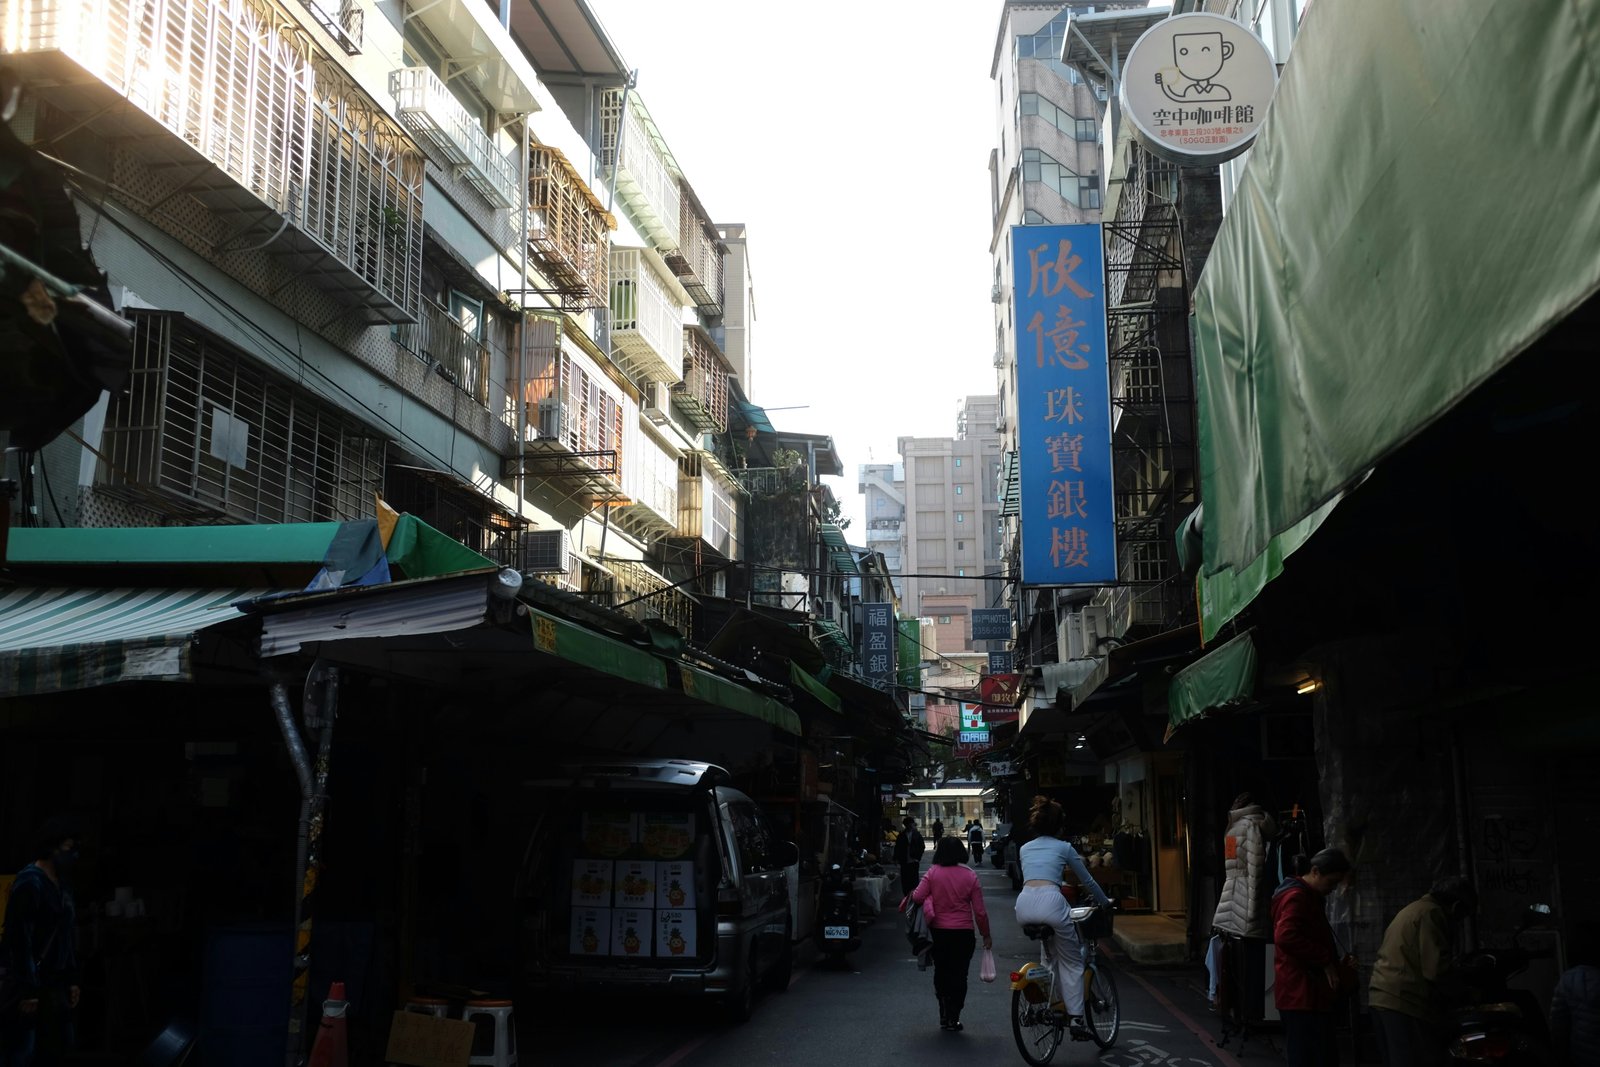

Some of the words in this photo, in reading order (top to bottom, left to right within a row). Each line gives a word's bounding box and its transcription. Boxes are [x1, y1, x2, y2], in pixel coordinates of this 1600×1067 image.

[1153, 105, 1254, 126] 空中咖啡館
